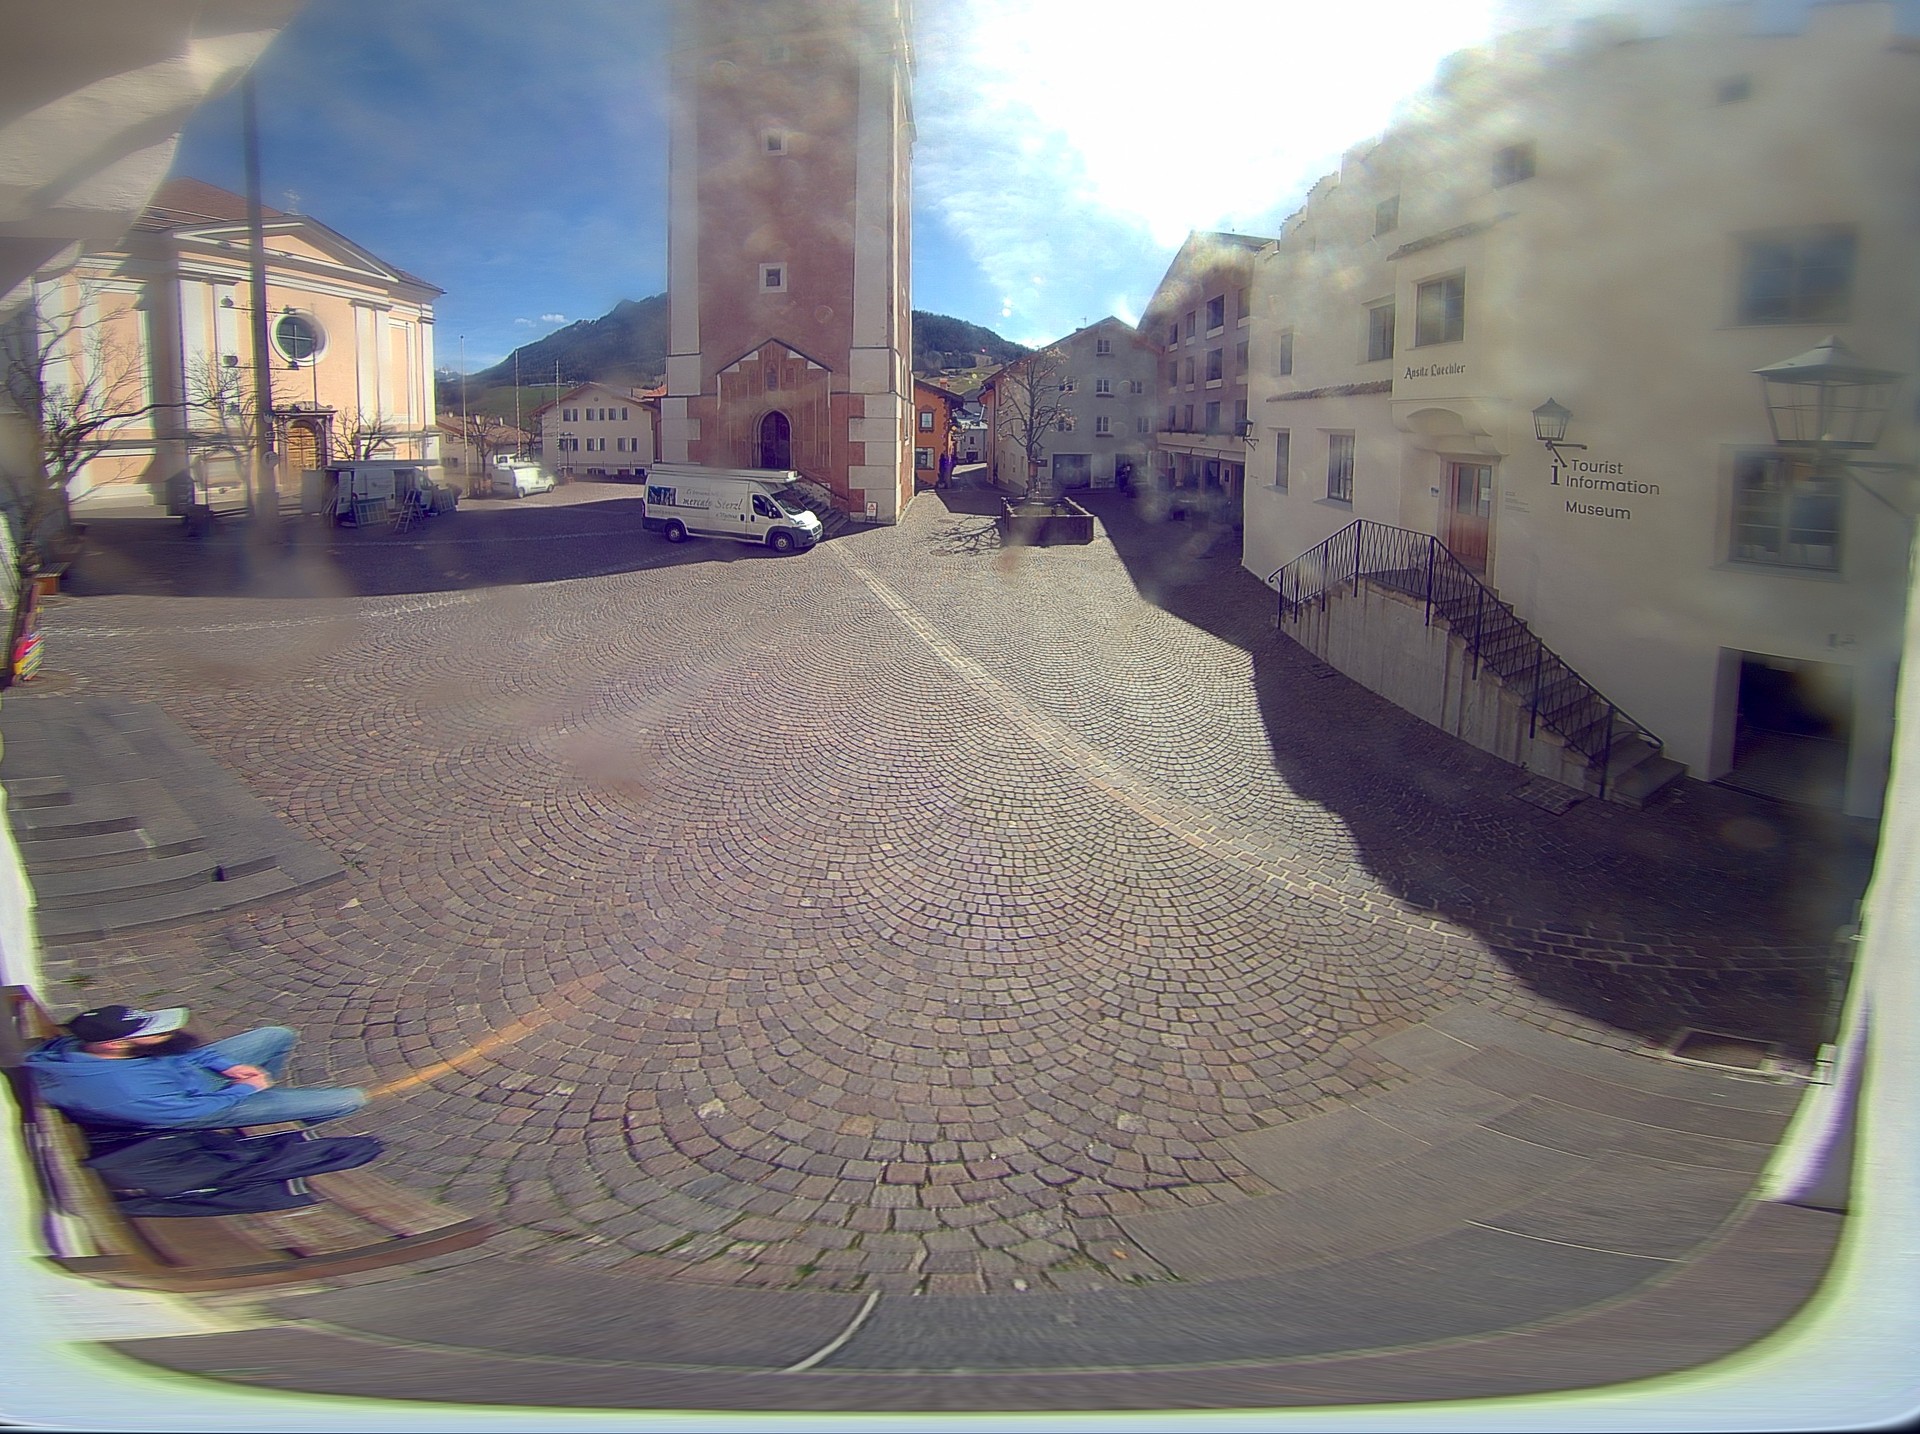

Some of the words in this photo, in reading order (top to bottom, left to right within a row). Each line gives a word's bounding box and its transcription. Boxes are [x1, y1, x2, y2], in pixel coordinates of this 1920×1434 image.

[1404, 366, 1428, 380] Ansitz
[1571, 459, 1624, 475] Tourist
[1566, 475, 1660, 495] Information
[1566, 500, 1631, 520] Museum
